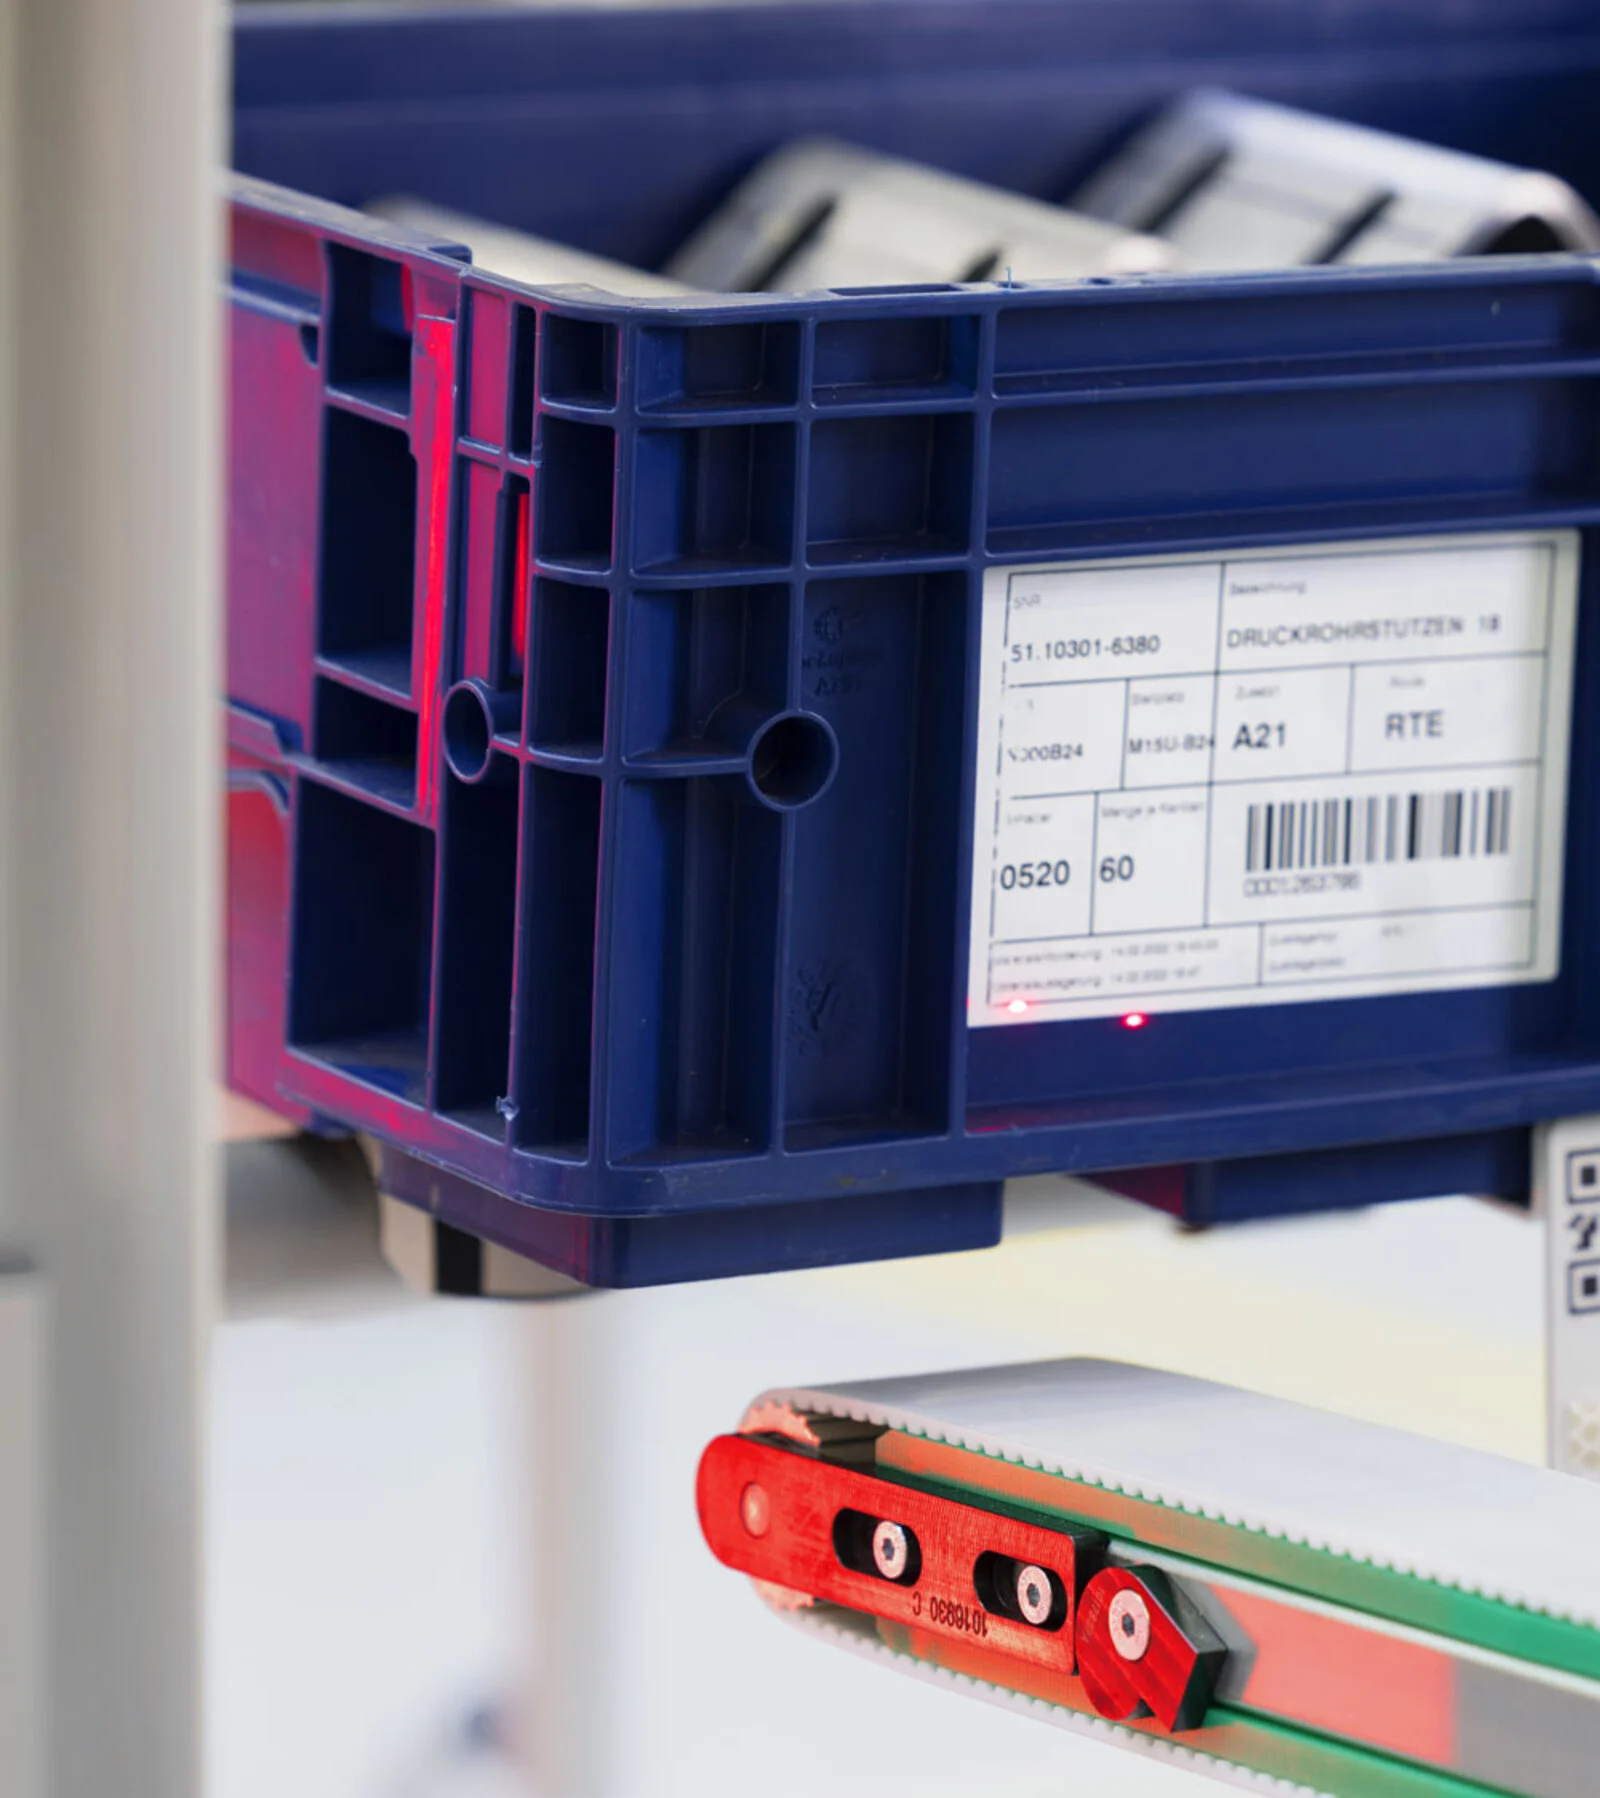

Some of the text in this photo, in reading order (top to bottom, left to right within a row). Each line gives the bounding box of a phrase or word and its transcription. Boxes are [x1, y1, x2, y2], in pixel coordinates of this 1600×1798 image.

[1011, 634, 1162, 663] 51.10301-6380
[1232, 721, 1287, 751] A21
[1385, 708, 1445, 741] RTE
[1000, 859, 1071, 891] 0520
[1099, 855, 1135, 884] 60
[912, 1590, 922, 1616] C
